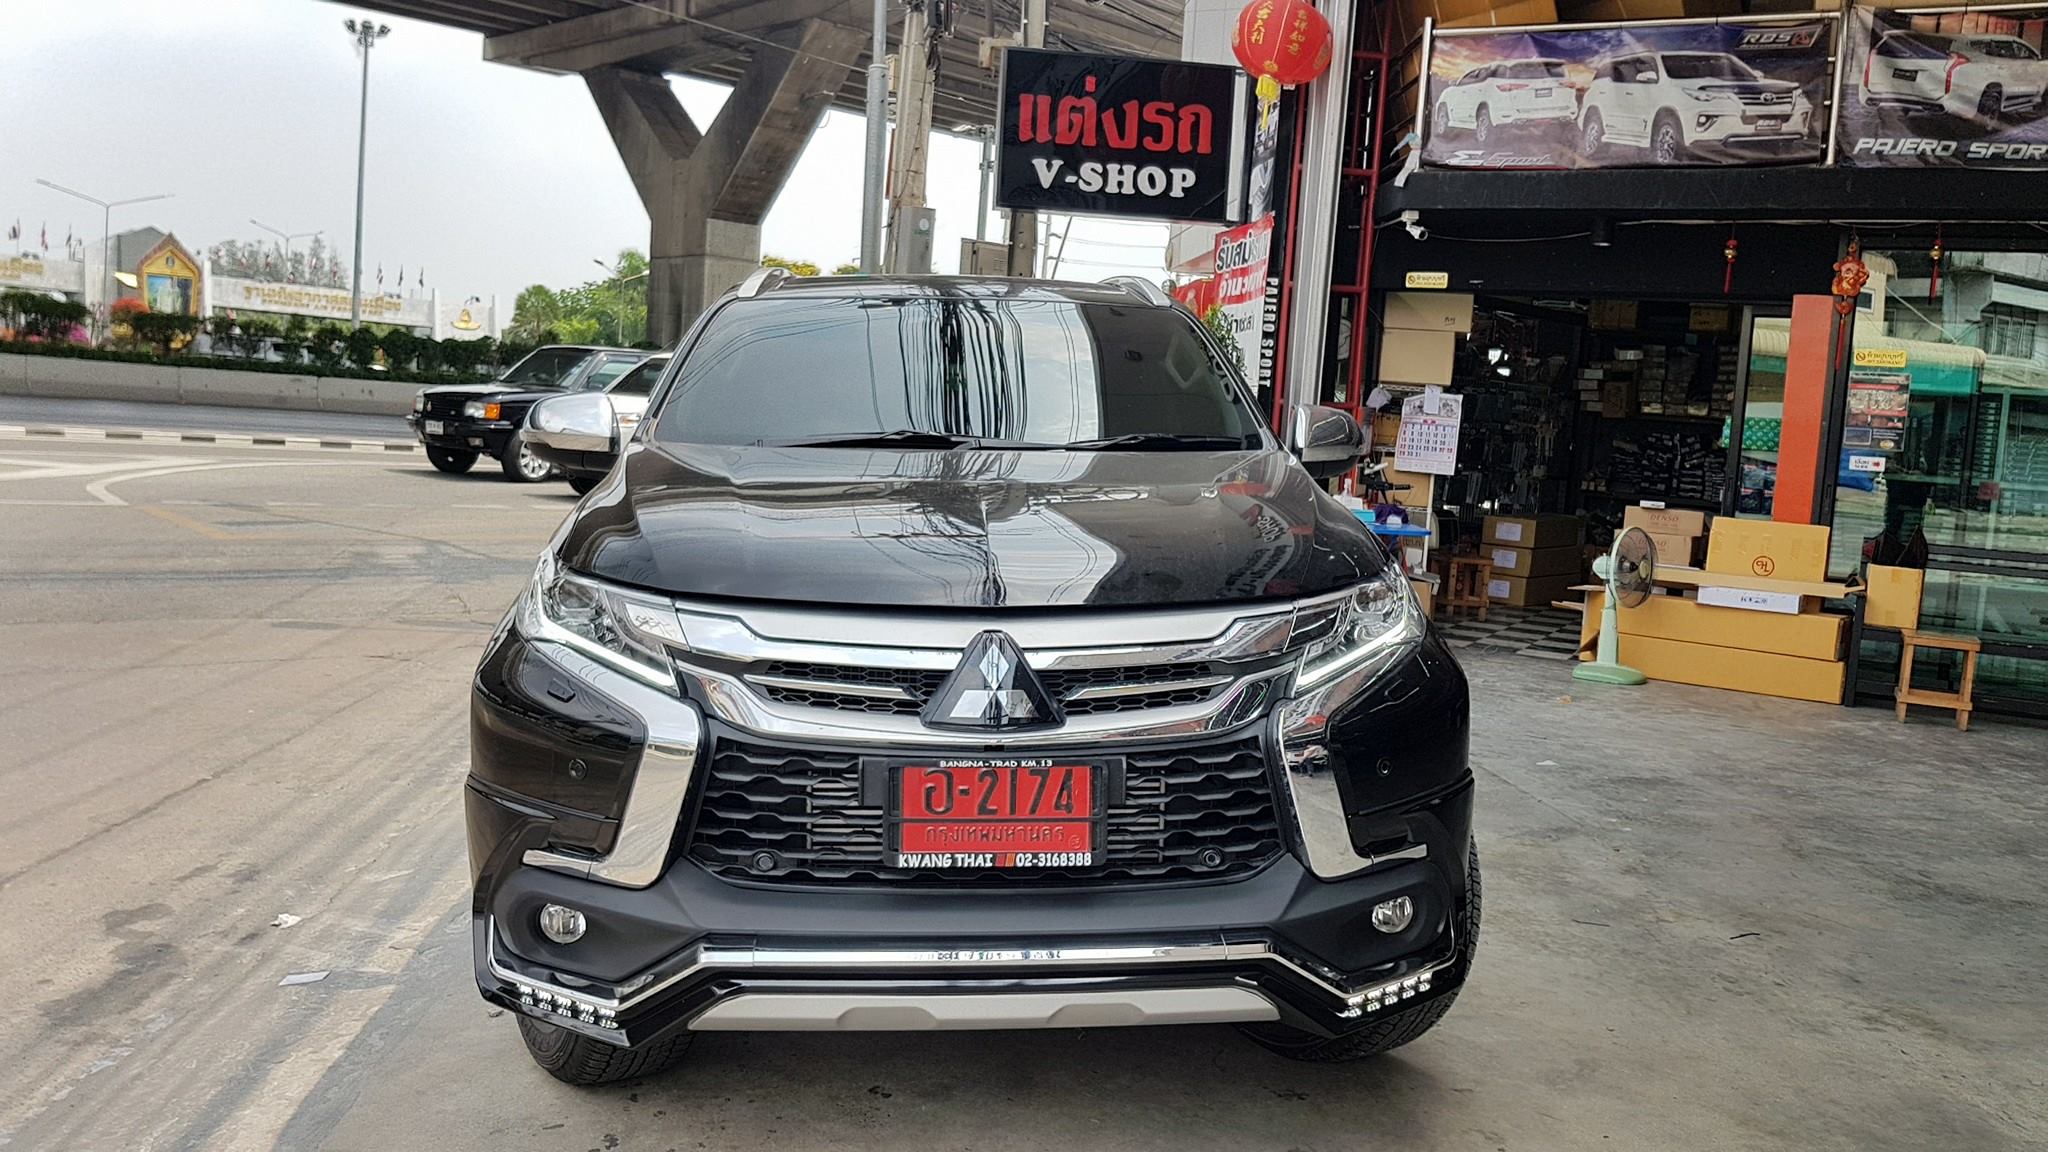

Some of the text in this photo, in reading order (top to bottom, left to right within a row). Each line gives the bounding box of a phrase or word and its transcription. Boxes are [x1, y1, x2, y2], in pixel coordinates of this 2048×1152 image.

[1853, 137, 2048, 160] PAJERO SPOR
[1031, 157, 1197, 198] V-SHOP
[1258, 277, 1279, 388] PAJERO SPORT
[939, 760, 1053, 768] BANGNA-TRAD KM.13
[925, 825, 1065, 847] กรุงเทพมหานคร
[899, 853, 1092, 868] KWANG THAI 02-3168388
